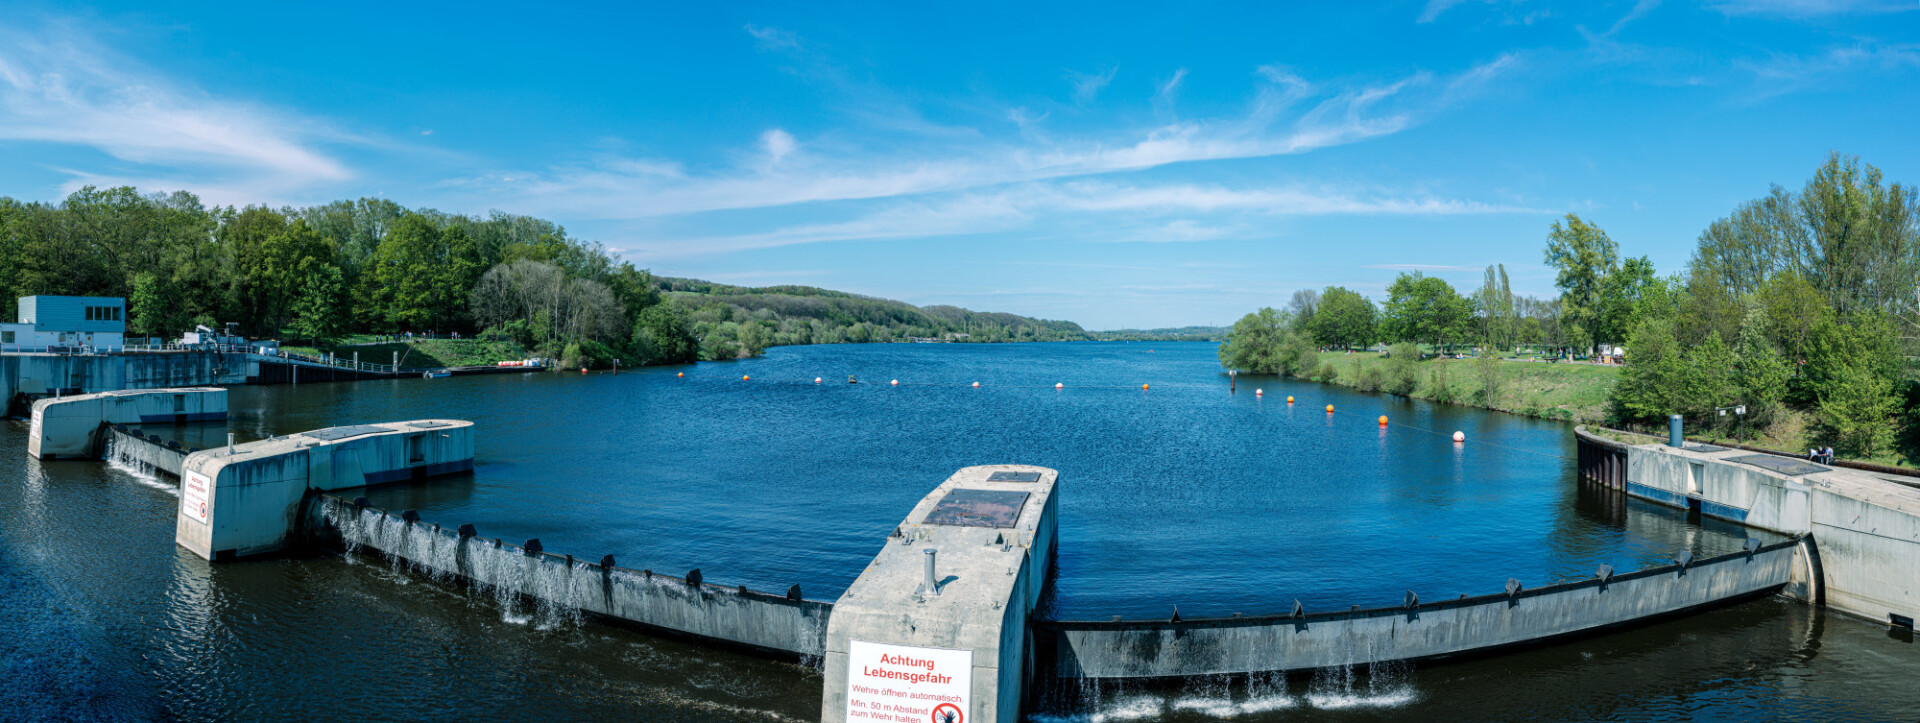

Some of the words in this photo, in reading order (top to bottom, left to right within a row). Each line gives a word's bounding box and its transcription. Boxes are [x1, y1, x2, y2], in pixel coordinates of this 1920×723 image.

[880, 653, 934, 670] Achtung
[864, 666, 952, 684] Lebensgefahr
[852, 684, 879, 694] Wehre
[881, 687, 907, 697] öffnen
[910, 691, 964, 703] automatisch.
[851, 699, 867, 708] Min.
[870, 701, 881, 710] 50
[893, 705, 928, 715] Abstand
[850, 710, 868, 718] zum
[870, 711, 893, 721] Wehr
[895, 714, 921, 723] halten
